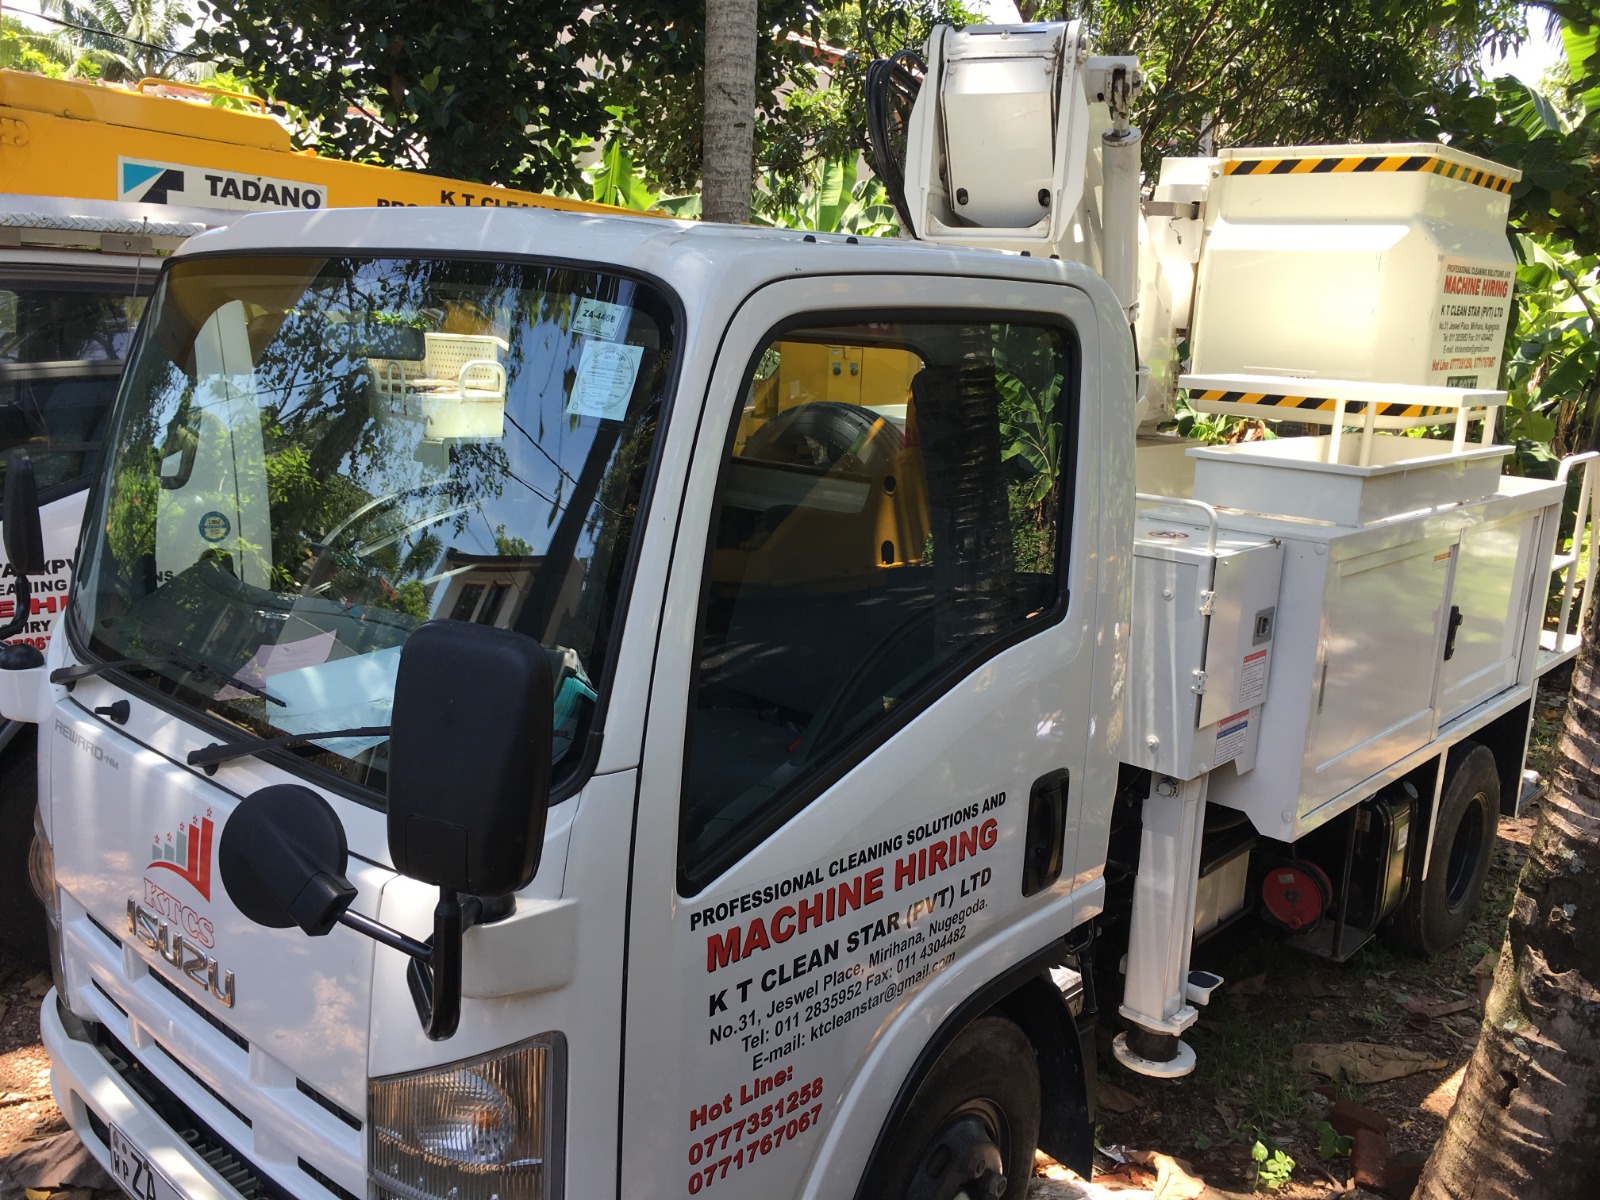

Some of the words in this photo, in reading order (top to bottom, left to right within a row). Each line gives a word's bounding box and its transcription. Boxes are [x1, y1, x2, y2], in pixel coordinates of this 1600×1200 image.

[204, 174, 321, 210] TADANO
[440, 190, 456, 206] K
[1440, 304, 1446, 315] K
[1450, 305, 1468, 316] CLEAN
[1468, 305, 1481, 317] STAR
[1443, 275, 1481, 296] MACHINE
[1481, 278, 1508, 298] HIRING
[690, 867, 824, 931] PROFESSIONAL
[828, 834, 903, 878] CLEANING
[906, 802, 979, 842] SOLUTIONS
[981, 791, 1007, 814] AND
[706, 866, 884, 973] MACHINE
[894, 817, 999, 891] HIRING
[126, 895, 235, 1009] ISUZU
[143, 877, 214, 949] KTCS
[708, 988, 729, 1017] K
[736, 979, 754, 1003] T
[760, 938, 839, 992] CLEAN
[846, 911, 901, 952] STAR
[904, 885, 956, 930] (PVT)
[960, 867, 992, 898] LTD
[709, 1007, 762, 1045] No.31,
[766, 979, 819, 1018] Jeswel
[823, 962, 865, 993] Place,
[868, 933, 926, 969] Mirihana,
[928, 899, 989, 937] Nugegoda.
[741, 1030, 771, 1054] Tel:
[774, 1013, 800, 1038] 011
[804, 982, 863, 1023] 2835952
[866, 968, 893, 991] Fax:
[896, 949, 917, 973] 011
[919, 925, 967, 961] 4304482
[752, 1034, 806, 1072] E-mail:
[809, 950, 957, 1041] ktcleanstar@gmail.com
[687, 1077, 824, 1166] 0777351258
[689, 1093, 733, 1132] Hot
[739, 1065, 794, 1105] Line:
[687, 1103, 824, 1195] 0771767067
